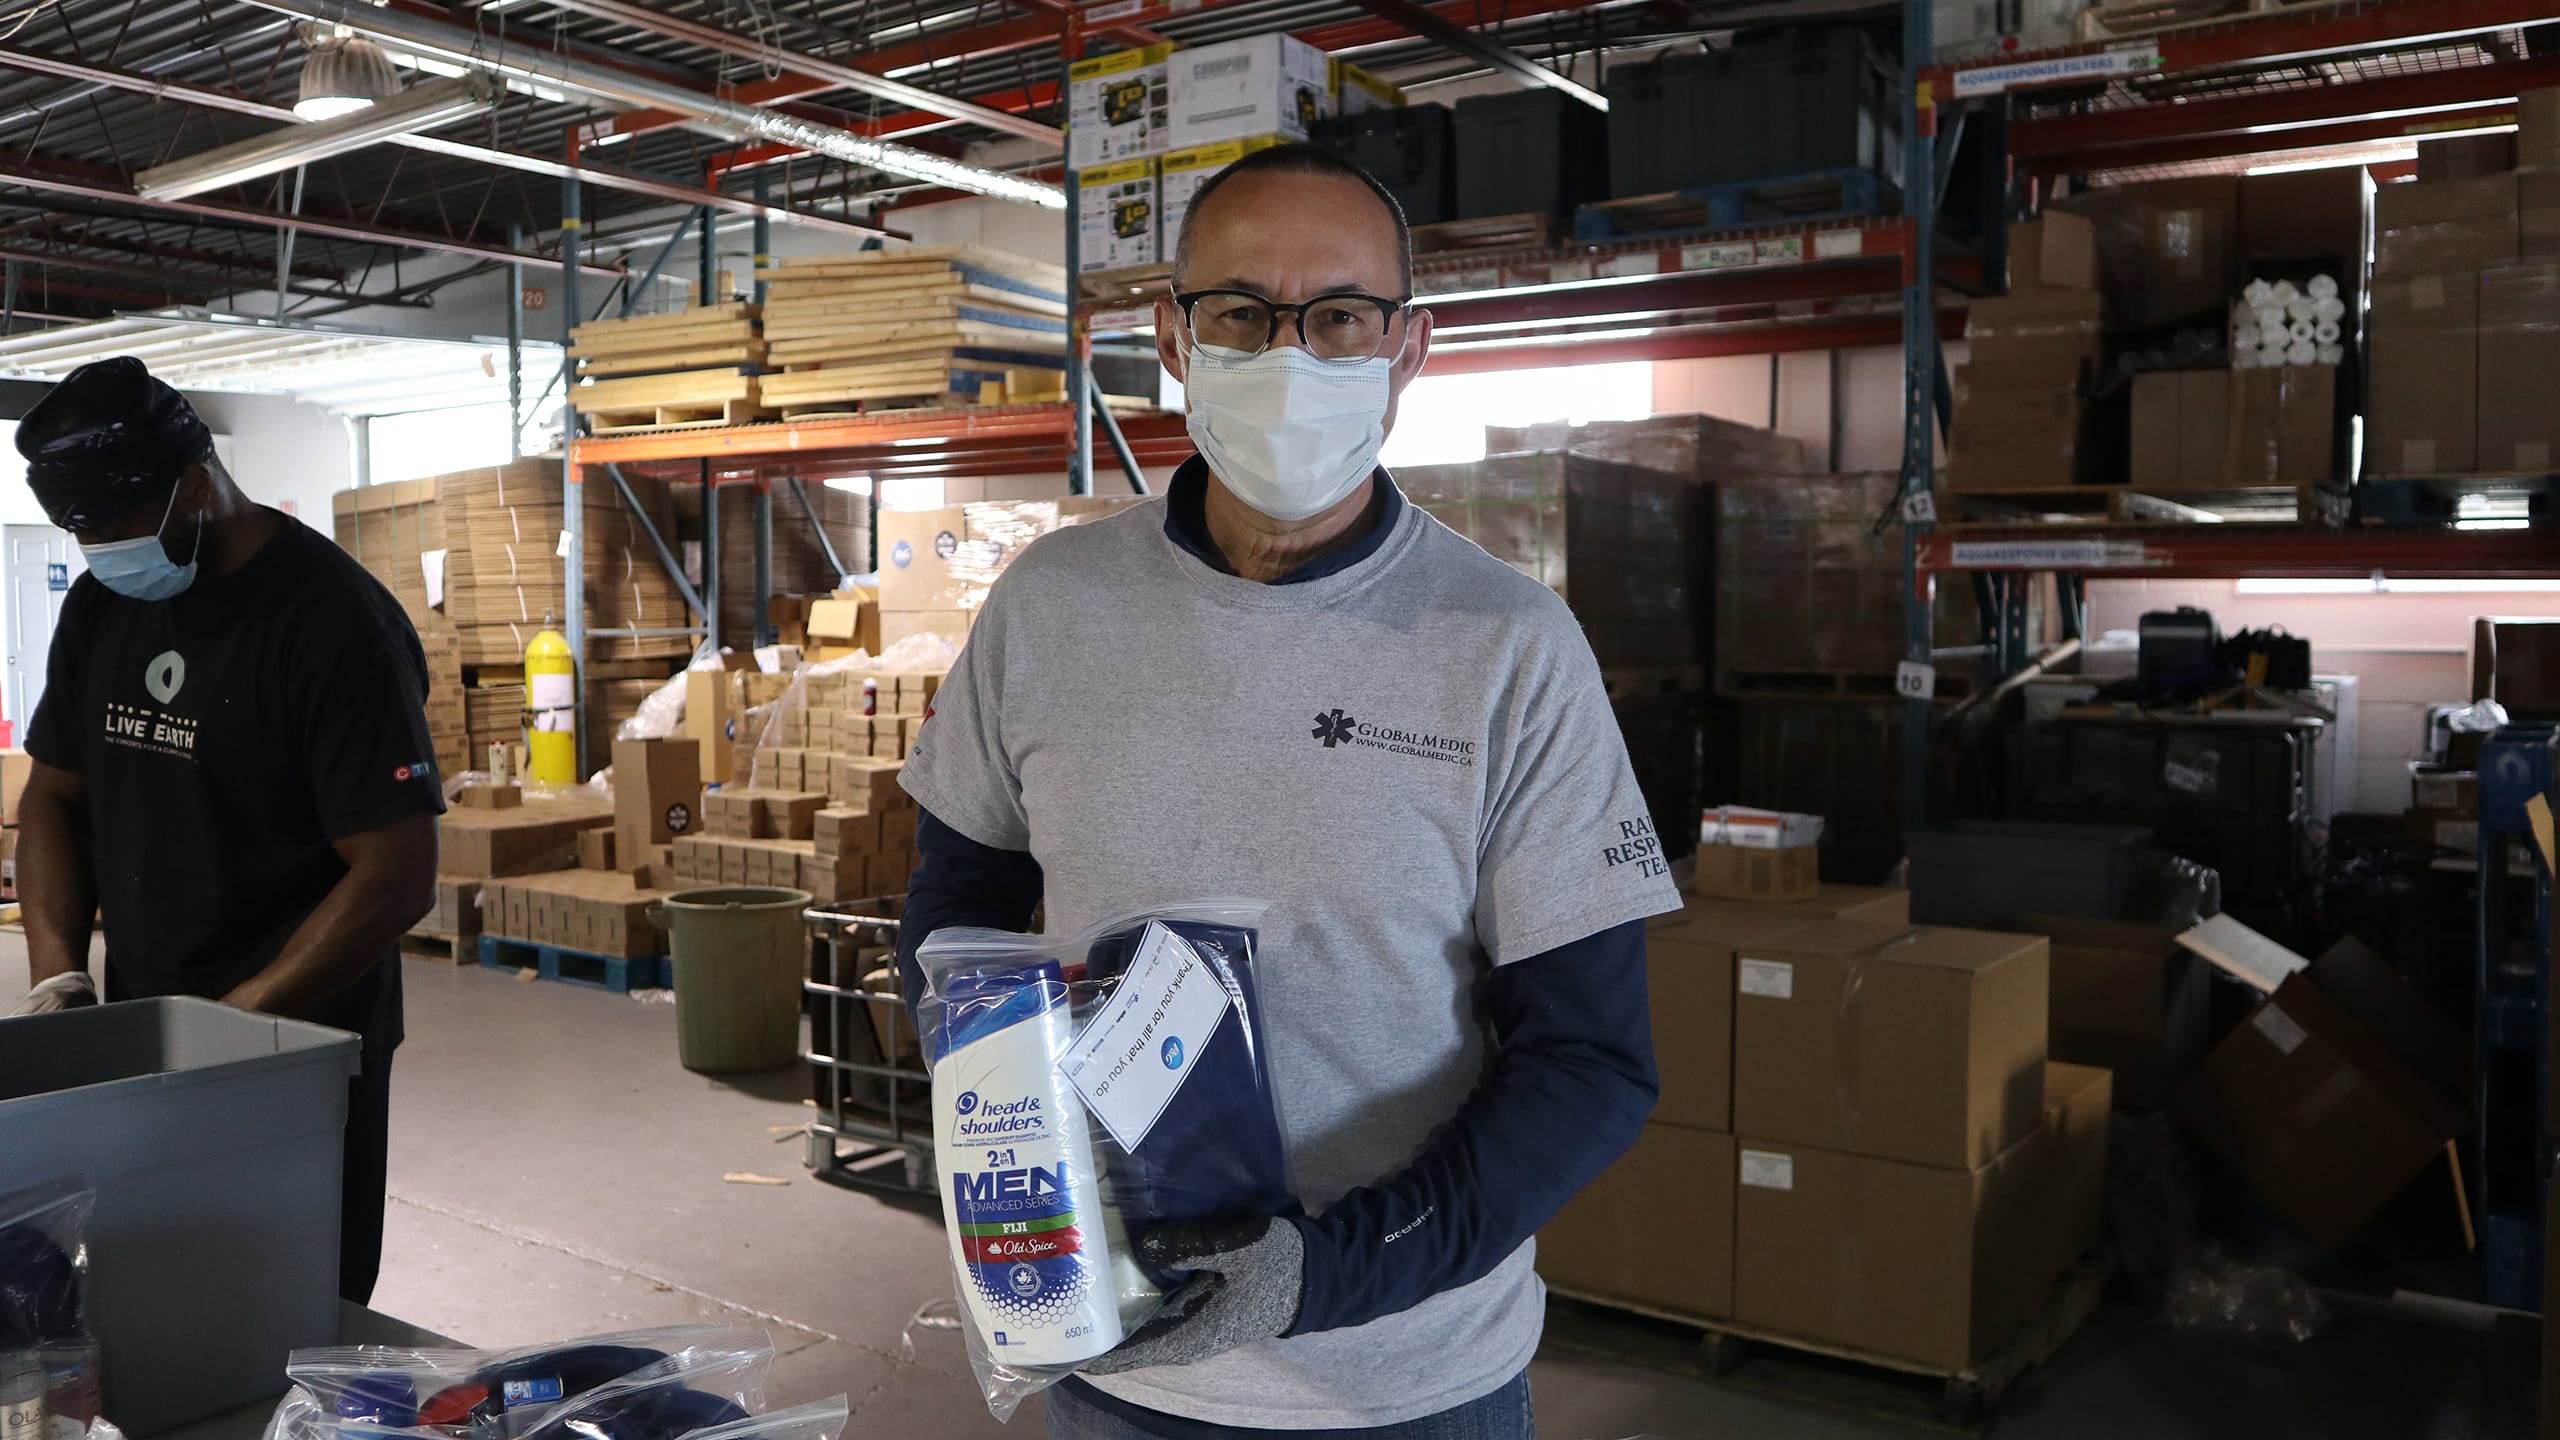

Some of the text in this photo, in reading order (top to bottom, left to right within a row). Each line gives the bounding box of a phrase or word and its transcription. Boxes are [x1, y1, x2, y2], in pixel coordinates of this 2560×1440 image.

[2063, 56, 2114, 73] FILTERS
[1901, 674, 1923, 691] 10
[105, 714, 195, 749] LIVE EARTH
[1355, 737, 1473, 767] WWW.GLOBALMEDIC.CA
[1172, 958, 1194, 992] Thank
[1160, 985, 1176, 1009] you
[1152, 1009, 1166, 1027] for
[1141, 1023, 1154, 1042] all
[1128, 1037, 1146, 1063] that
[1164, 1042, 1181, 1066] P&G
[1108, 1055, 1130, 1082] you
[1093, 1079, 1110, 1099] do.
[981, 1096, 1042, 1117] head &
[960, 1115, 1043, 1135] shoulders
[986, 1150, 1000, 1168] 2
[953, 1161, 1070, 1201] MEN
[966, 1193, 1060, 1213] ADVANCED SERIES
[1002, 1222, 1028, 1234] FIJI
[1003, 1238, 1055, 1255] Old Spice
[1064, 1326, 1081, 1339] 650
